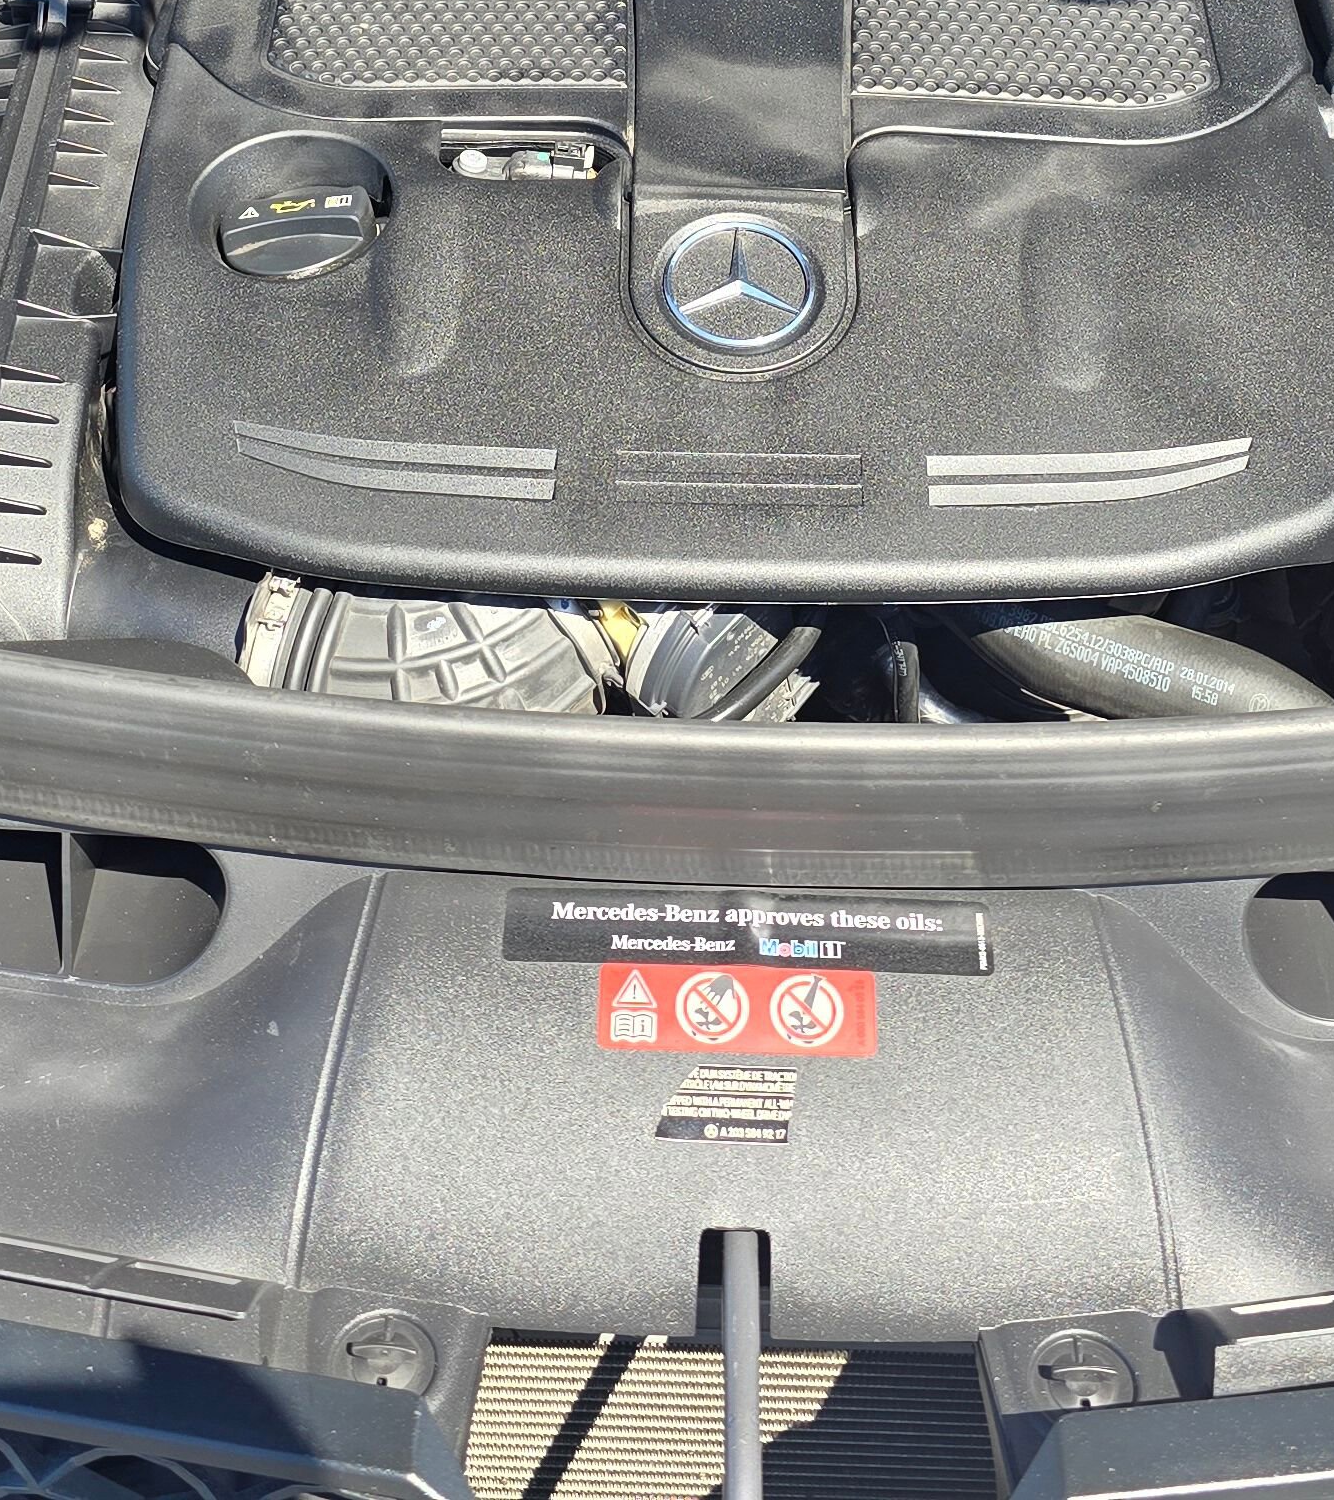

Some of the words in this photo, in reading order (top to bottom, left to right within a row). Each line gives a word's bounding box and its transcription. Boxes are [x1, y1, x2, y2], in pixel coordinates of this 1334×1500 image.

[1179, 665, 1236, 696] 28.01.2014
[1191, 684, 1219, 706] 15:58
[551, 901, 720, 923] Mercedes-Benz
[724, 908, 825, 927] approves
[829, 909, 892, 929] these
[895, 913, 944, 932] oils:
[610, 934, 736, 952] Mercedes-Benz
[758, 937, 819, 958] Mobil
